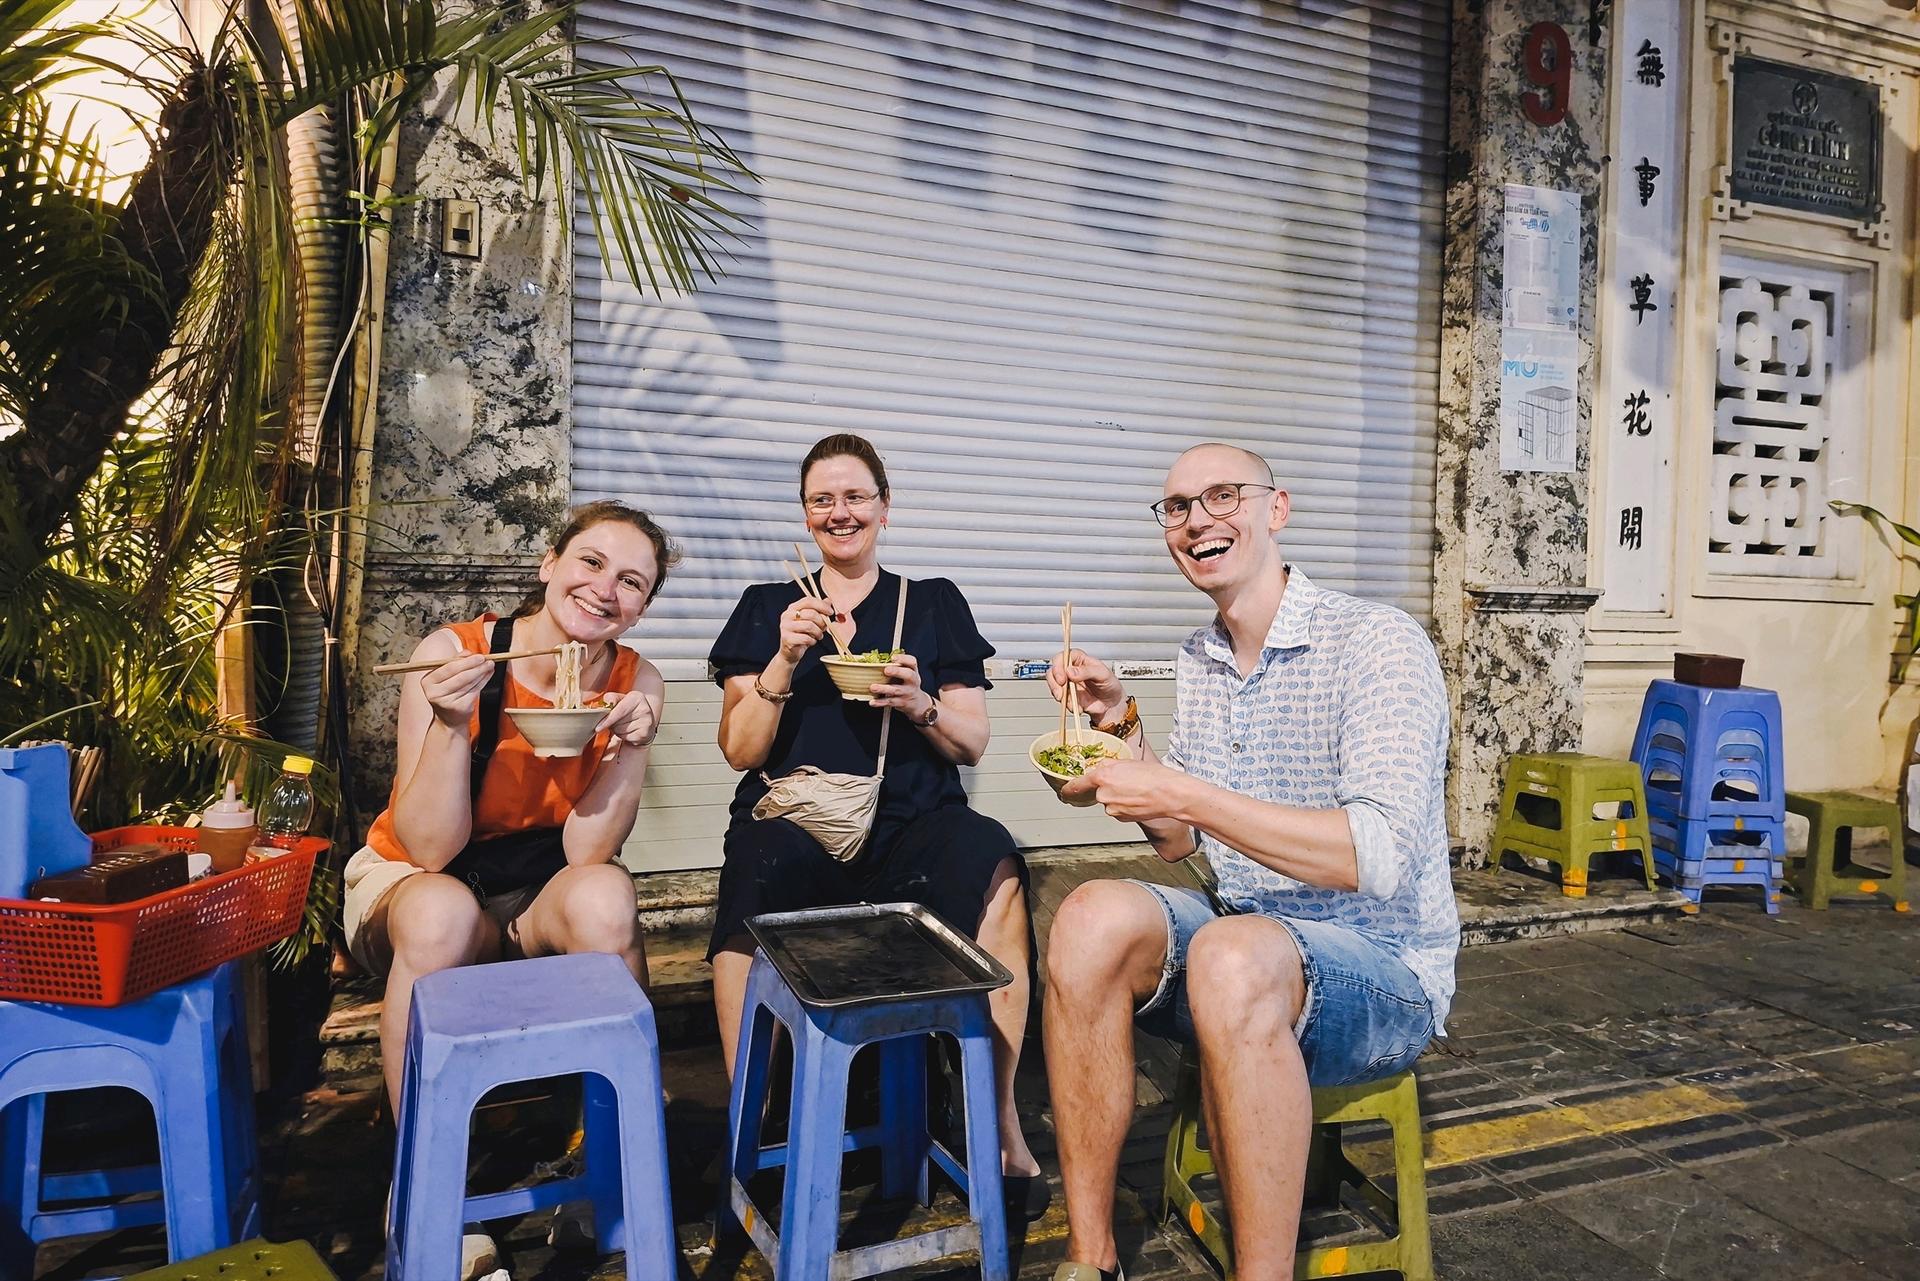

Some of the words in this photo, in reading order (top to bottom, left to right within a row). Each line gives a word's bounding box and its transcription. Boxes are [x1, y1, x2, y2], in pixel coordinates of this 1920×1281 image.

[1520, 21, 1571, 128] 9
[1619, 38, 1666, 551] 無事草花開
